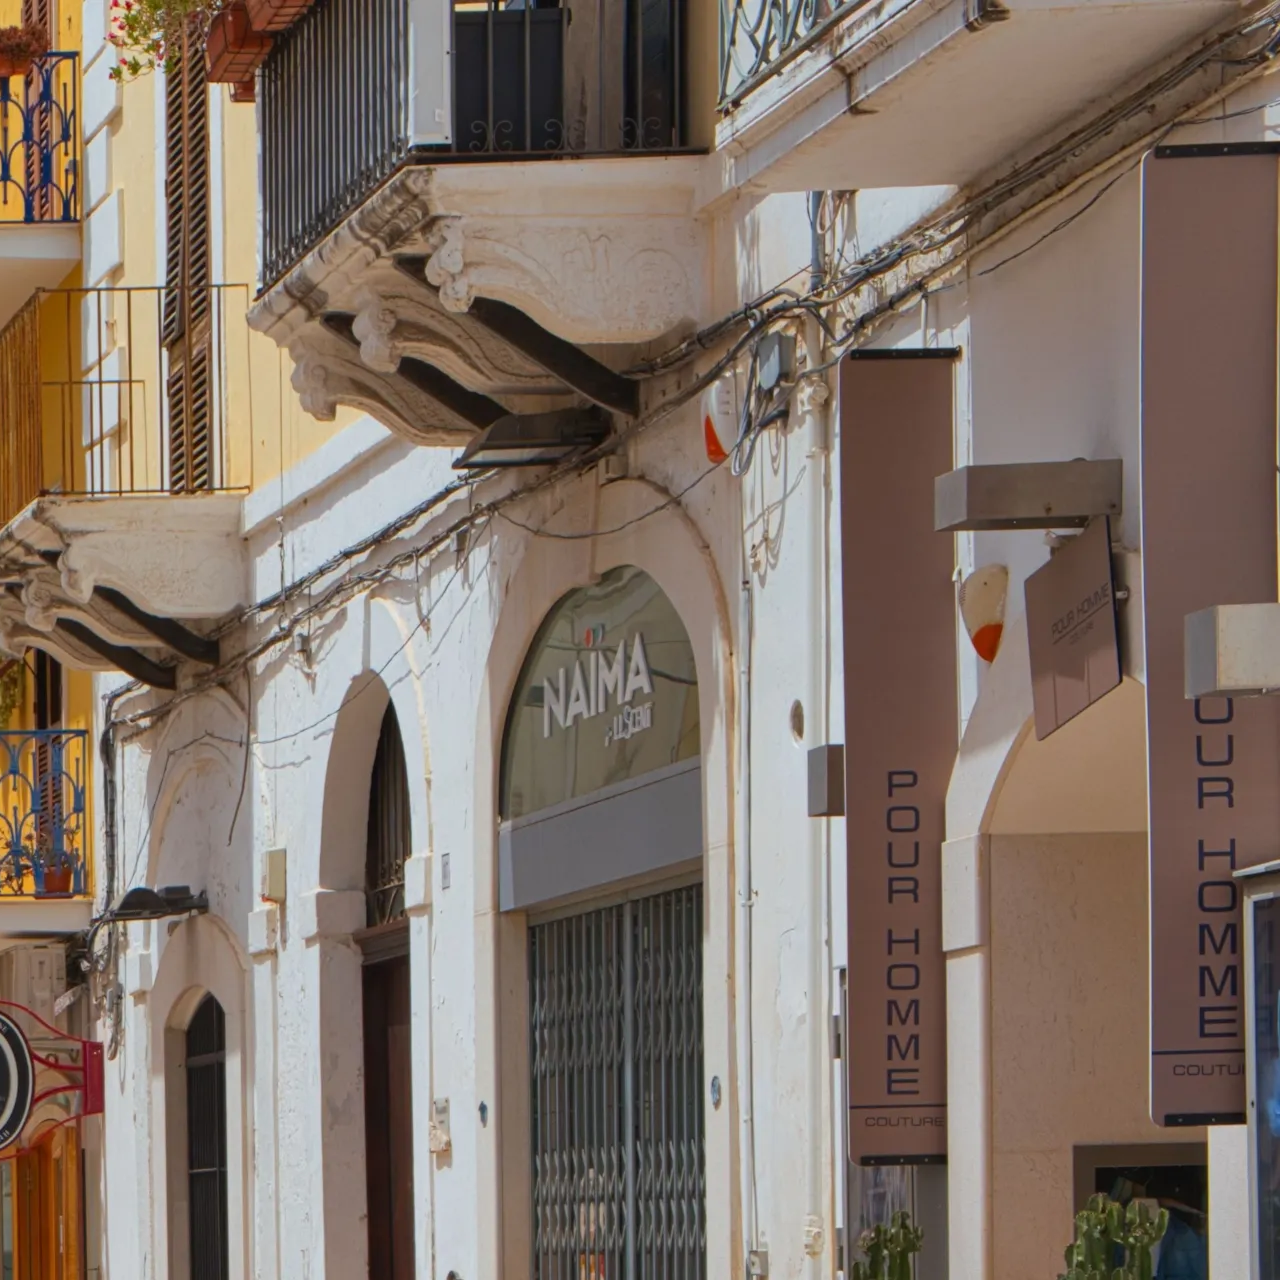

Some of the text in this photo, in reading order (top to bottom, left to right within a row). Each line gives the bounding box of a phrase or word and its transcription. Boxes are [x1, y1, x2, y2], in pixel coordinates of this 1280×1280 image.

[543, 631, 653, 738] NAIMA
[886, 770, 920, 1096] POUR HOMME
[1194, 697, 1238, 1039] OUR HOMME
[864, 1117, 944, 1127] COUTURE
